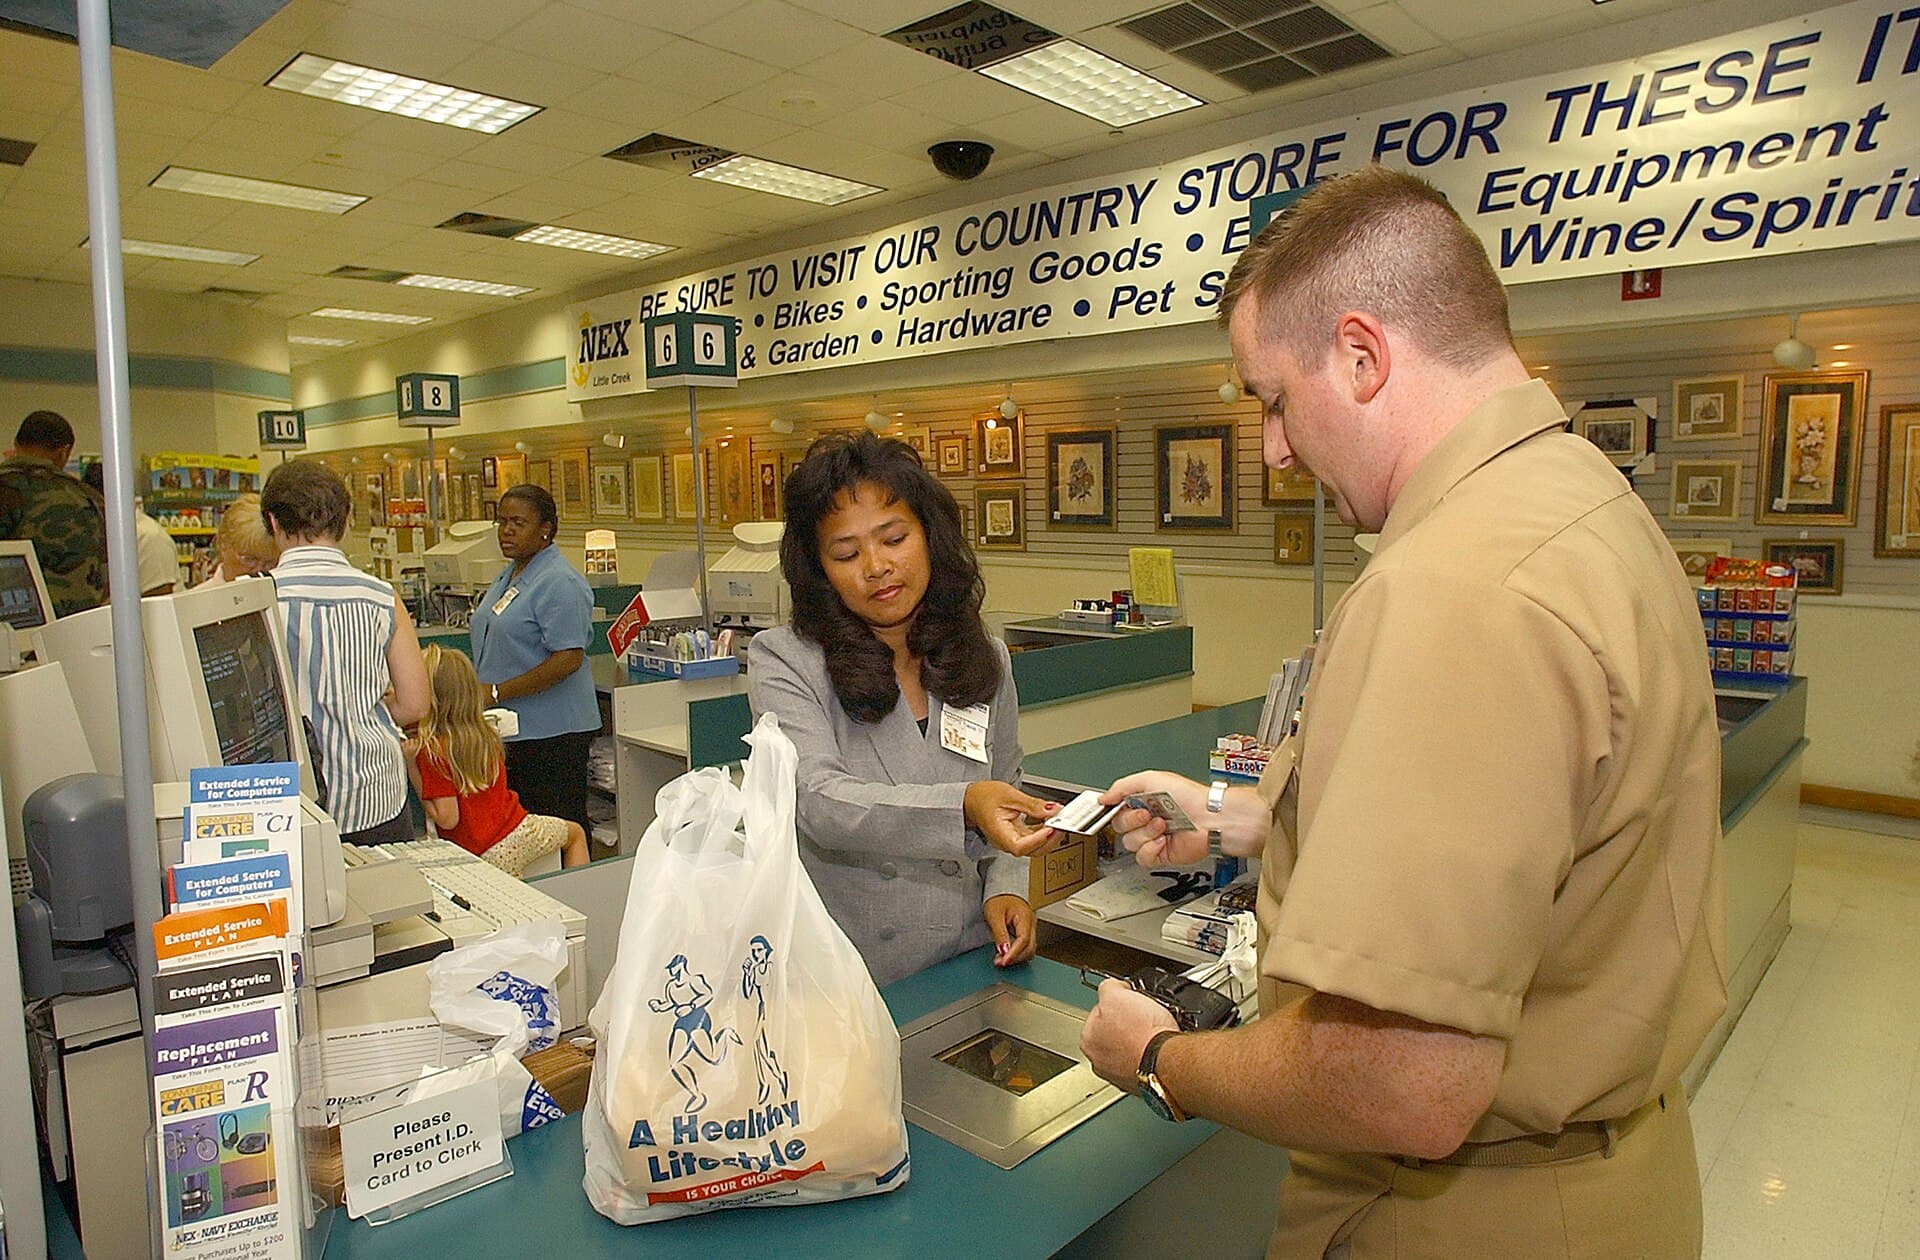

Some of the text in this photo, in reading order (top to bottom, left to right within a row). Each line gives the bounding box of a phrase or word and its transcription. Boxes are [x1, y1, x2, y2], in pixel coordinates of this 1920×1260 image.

[640, 291, 668, 323] BE
[676, 273, 736, 312] SURE
[748, 264, 778, 300] TO
[792, 244, 867, 291] VISIT
[873, 225, 942, 273] OUR
[954, 179, 1158, 256] COUNTRY
[1173, 132, 1347, 215] STORE
[1371, 102, 1507, 167] FOR
[1543, 31, 1822, 144] THESE
[773, 296, 844, 330] Bikes
[880, 262, 1014, 312] Sporting
[1028, 235, 1163, 284] Goods
[1476, 102, 1889, 215] Equipment
[741, 345, 756, 369] &
[767, 331, 859, 367] Garden
[896, 299, 1052, 348] Hardware
[1108, 281, 1176, 320] Pet
[579, 319, 632, 364] NEX
[663, 334, 672, 362] 6
[702, 331, 714, 360] 6
[593, 372, 631, 387] Little Creek
[431, 386, 442, 406] 8
[276, 420, 295, 436] 10
[199, 776, 290, 790] Extended Service
[207, 787, 282, 799] for Computers
[197, 823, 253, 838] CARE
[186, 868, 280, 890] Extended Service
[196, 880, 273, 898] for Computers
[165, 918, 263, 945] Extended Service
[194, 933, 238, 948] PLAN
[169, 973, 271, 1000] Extended Service
[200, 989, 245, 1004] PLAN
[213, 1005, 231, 1013] Form
[242, 999, 265, 1007] Cashier
[158, 1031, 269, 1063] Replacement
[190, 1051, 237, 1066] PLAN
[172, 1072, 186, 1080] Take
[189, 1069, 202, 1077] This
[204, 1066, 222, 1074] Form
[233, 1059, 257, 1068] Cashier
[241, 1071, 269, 1103] R
[161, 1091, 224, 1115] CARE
[393, 1110, 451, 1139] Please
[628, 1100, 800, 1149] A Healthy
[372, 1122, 473, 1168] Present I.D.
[367, 1139, 481, 1190] Card to Clerk
[648, 1139, 807, 1184] Lifestyle
[686, 1189, 698, 1200] IS
[701, 1181, 737, 1196] YOUR
[201, 1223, 227, 1238] NAVY
[228, 1212, 278, 1232] EXCHANGE
[198, 1246, 237, 1260] Purchases
[238, 1242, 251, 1253] Up
[253, 1240, 261, 1248] to
[264, 1234, 284, 1245] $200
